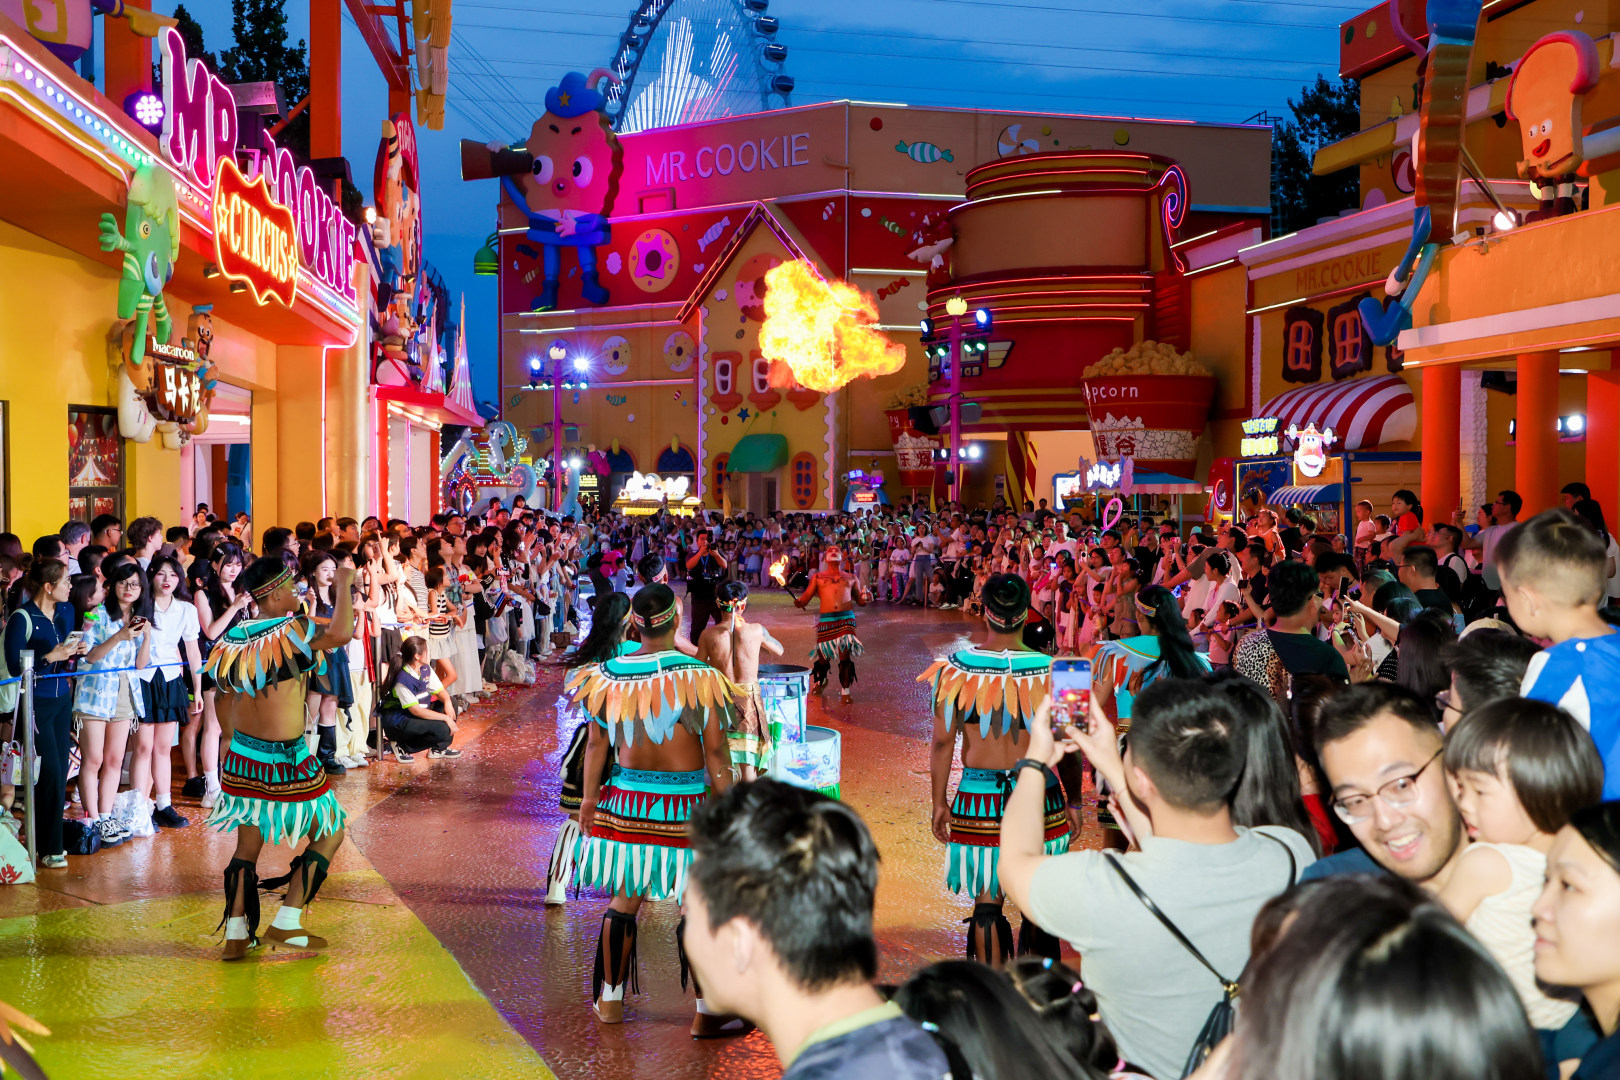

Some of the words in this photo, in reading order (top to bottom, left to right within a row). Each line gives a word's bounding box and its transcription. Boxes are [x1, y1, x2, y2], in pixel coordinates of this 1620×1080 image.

[646, 132, 810, 187] MR.COOKIE
[229, 193, 288, 284] CIRCUS
[262, 129, 357, 300] OOKIE
[1296, 251, 1381, 294] MR.COOKIE
[151, 336, 195, 361] Macaroon
